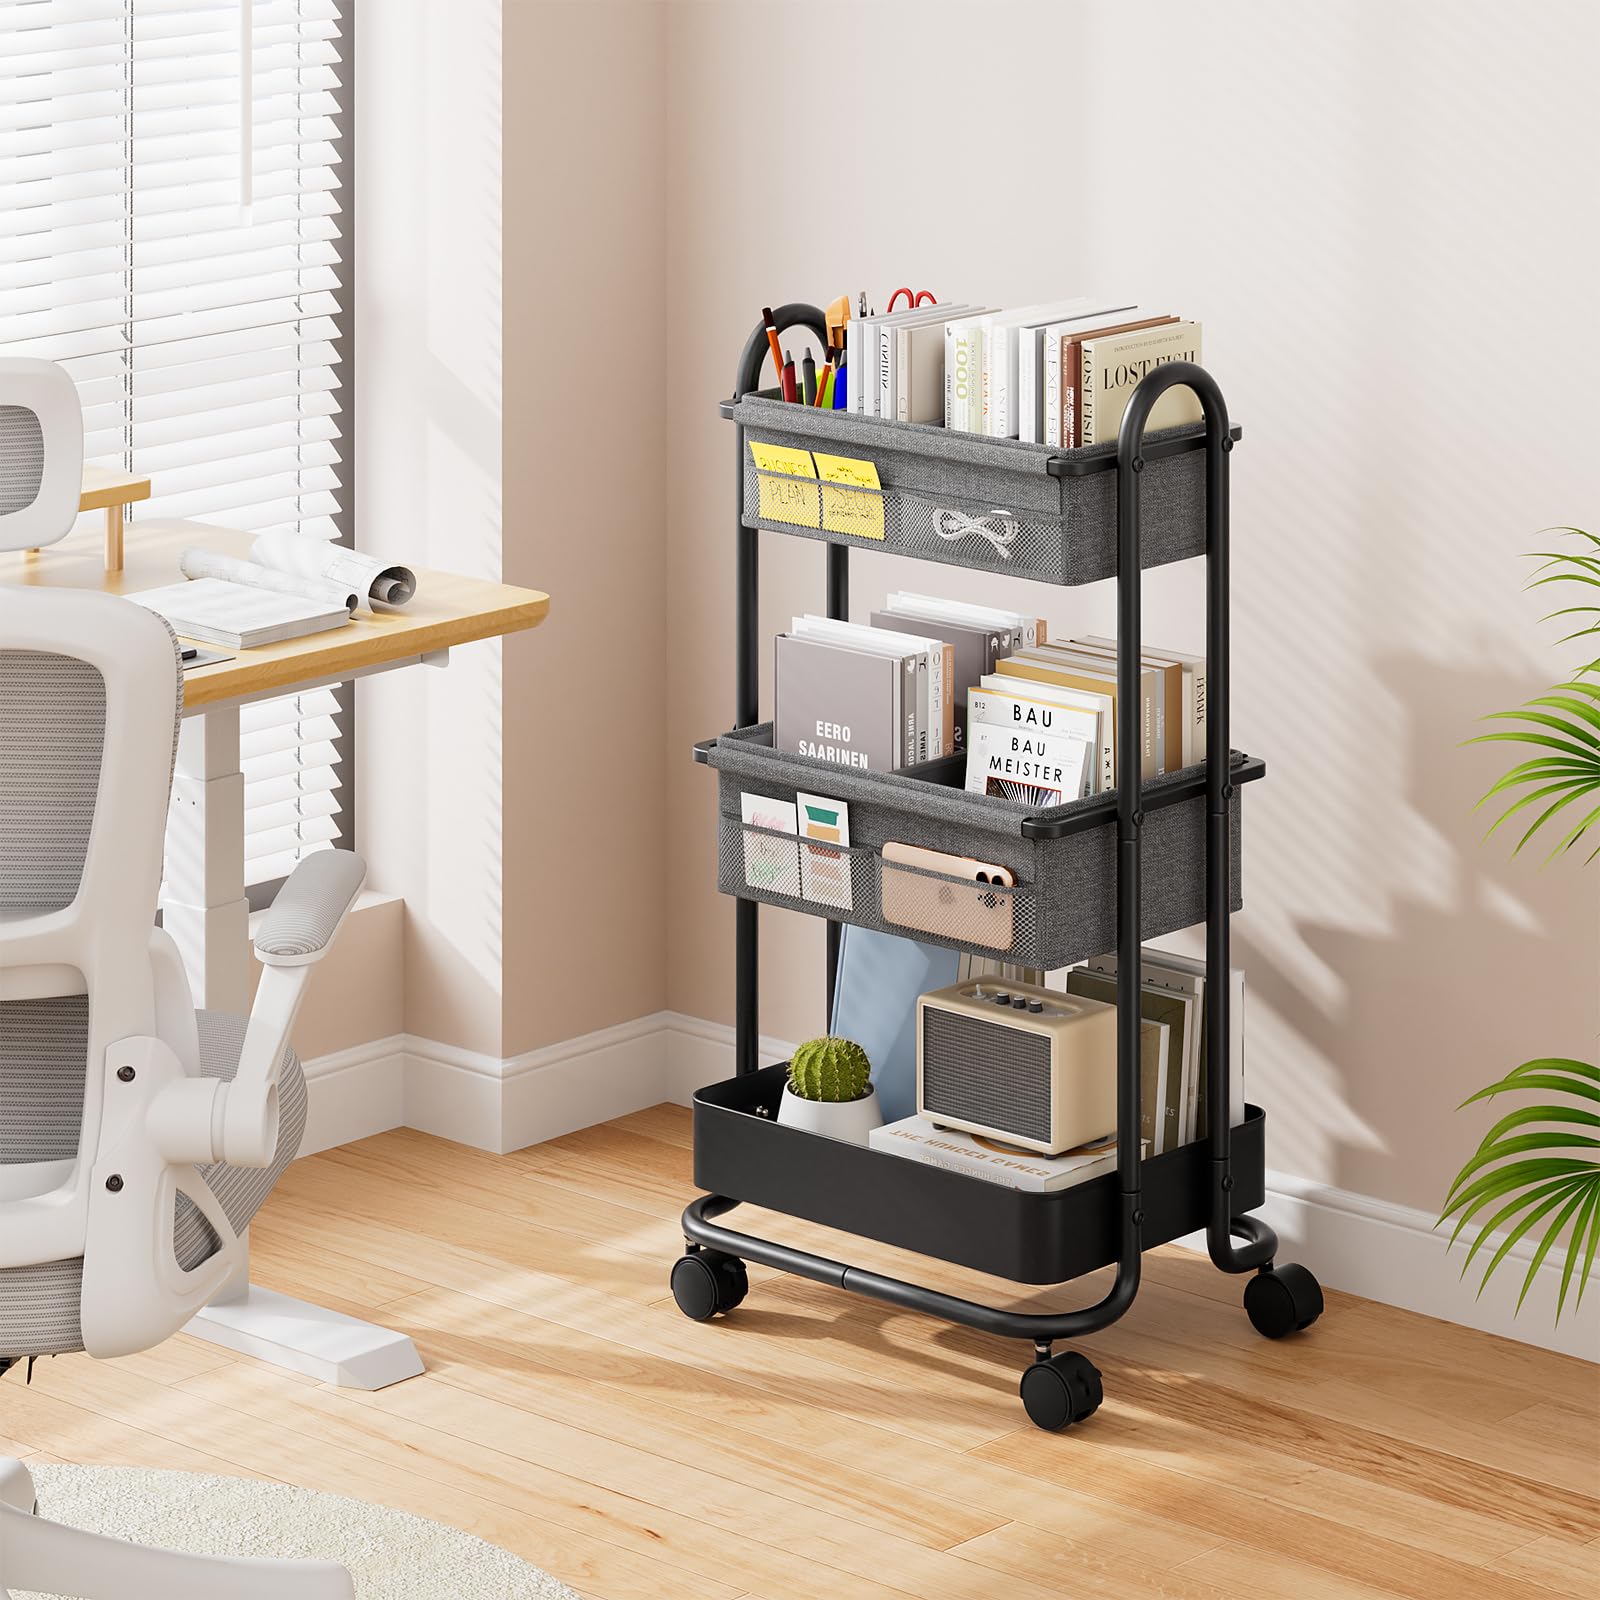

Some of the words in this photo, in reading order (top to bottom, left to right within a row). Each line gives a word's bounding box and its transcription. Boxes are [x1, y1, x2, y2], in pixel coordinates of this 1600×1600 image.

[956, 338, 968, 399] 1000
[1048, 335, 1057, 411] ALEXEY
[1084, 349, 1092, 398] LOST
[1104, 359, 1151, 390] LOST
[1084, 403, 1092, 443] FISH
[769, 481, 806, 505] PLAN
[974, 701, 986, 710] B12
[1013, 703, 1052, 728] BAU
[816, 720, 852, 742] EERO
[798, 740, 869, 769] SAARINEN
[1011, 737, 1046, 757] BAU
[989, 755, 1063, 783] MEISTER
